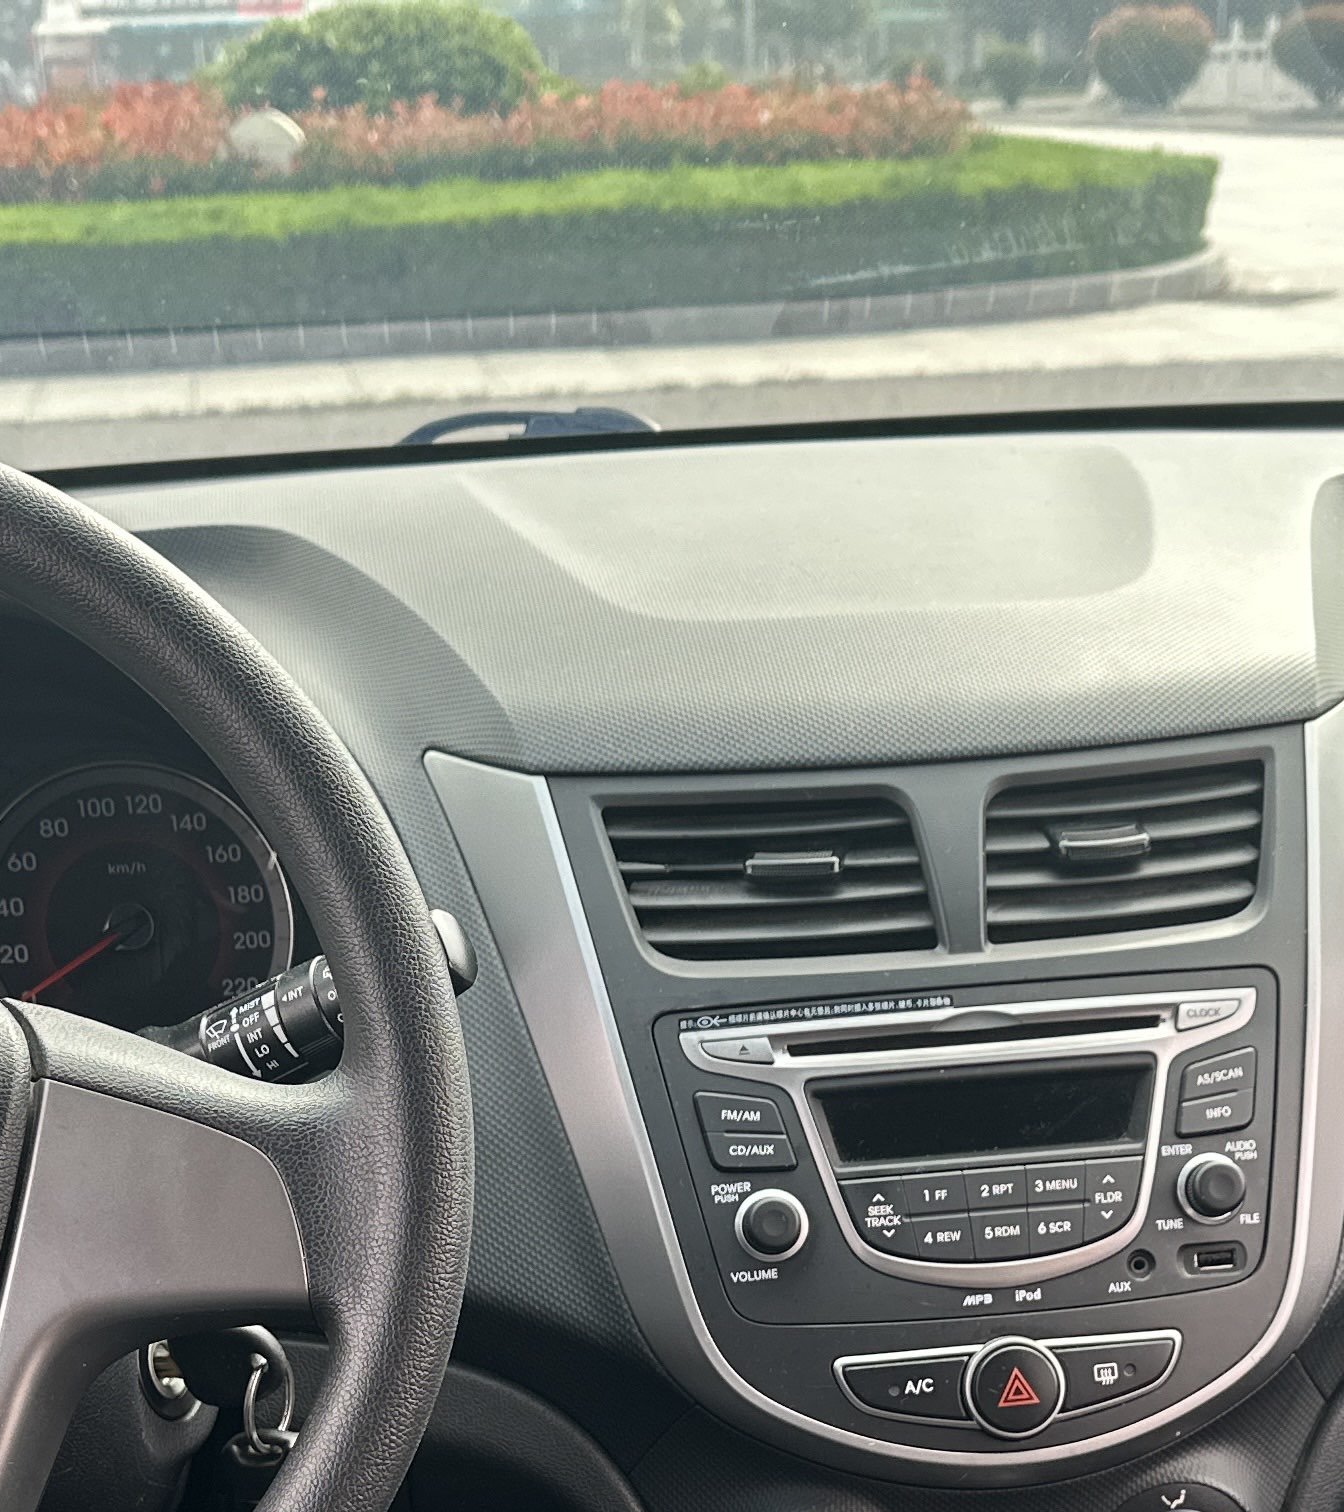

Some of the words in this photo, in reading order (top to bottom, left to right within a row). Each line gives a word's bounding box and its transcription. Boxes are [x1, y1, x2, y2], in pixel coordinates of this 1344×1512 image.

[77, 798, 115, 818] 100
[125, 795, 162, 815] 120
[39, 819, 69, 838] 80
[170, 812, 207, 833] 140
[206, 844, 241, 864] 160
[7, 853, 37, 873] 60
[107, 861, 147, 875] km/h
[228, 884, 264, 904] 180
[233, 931, 271, 950] 200
[0, 944, 29, 964] 20
[223, 979, 258, 995] 220
[287, 985, 305, 1001] INT
[239, 997, 261, 1014] MIST
[1186, 1007, 1222, 1018] CLOCK
[242, 1011, 260, 1027] OFF
[207, 1034, 231, 1053] FRONT
[247, 1029, 263, 1044] INT
[255, 1045, 270, 1058] LO
[266, 1060, 279, 1070] HI
[1196, 1067, 1244, 1085] AS/SCAN
[721, 1110, 761, 1122] FM/AM
[1205, 1106, 1231, 1119] INFO
[729, 1144, 775, 1156] CD/AUX
[1161, 1144, 1193, 1156] ENTER
[1225, 1139, 1257, 1153] AUDIO
[1234, 1150, 1258, 1160] PUSH
[711, 1182, 751, 1195] POWER
[981, 1184, 989, 1197] 2
[992, 1183, 1014, 1195] RPT
[1034, 1179, 1043, 1192] 3
[1045, 1178, 1078, 1191] MENU
[714, 1193, 739, 1204] PUSH
[923, 1189, 930, 1201] 1
[935, 1189, 948, 1201] FF
[1095, 1191, 1122, 1204] FLDR
[868, 1204, 894, 1216] SEEK
[865, 1215, 902, 1227] TRACK
[1156, 1219, 1184, 1230] TUNE
[1240, 1213, 1260, 1225] FILE
[984, 1226, 993, 1239] 5
[994, 1225, 1020, 1237] RDM
[1038, 1222, 1046, 1234] 6
[1048, 1221, 1071, 1233] SCR
[924, 1231, 933, 1244] 4
[936, 1230, 961, 1243] REW
[730, 1268, 779, 1283] VOLUME
[1108, 1281, 1132, 1293] AUX
[1015, 1288, 1042, 1302] iPod
[904, 1377, 935, 1395] A/C
